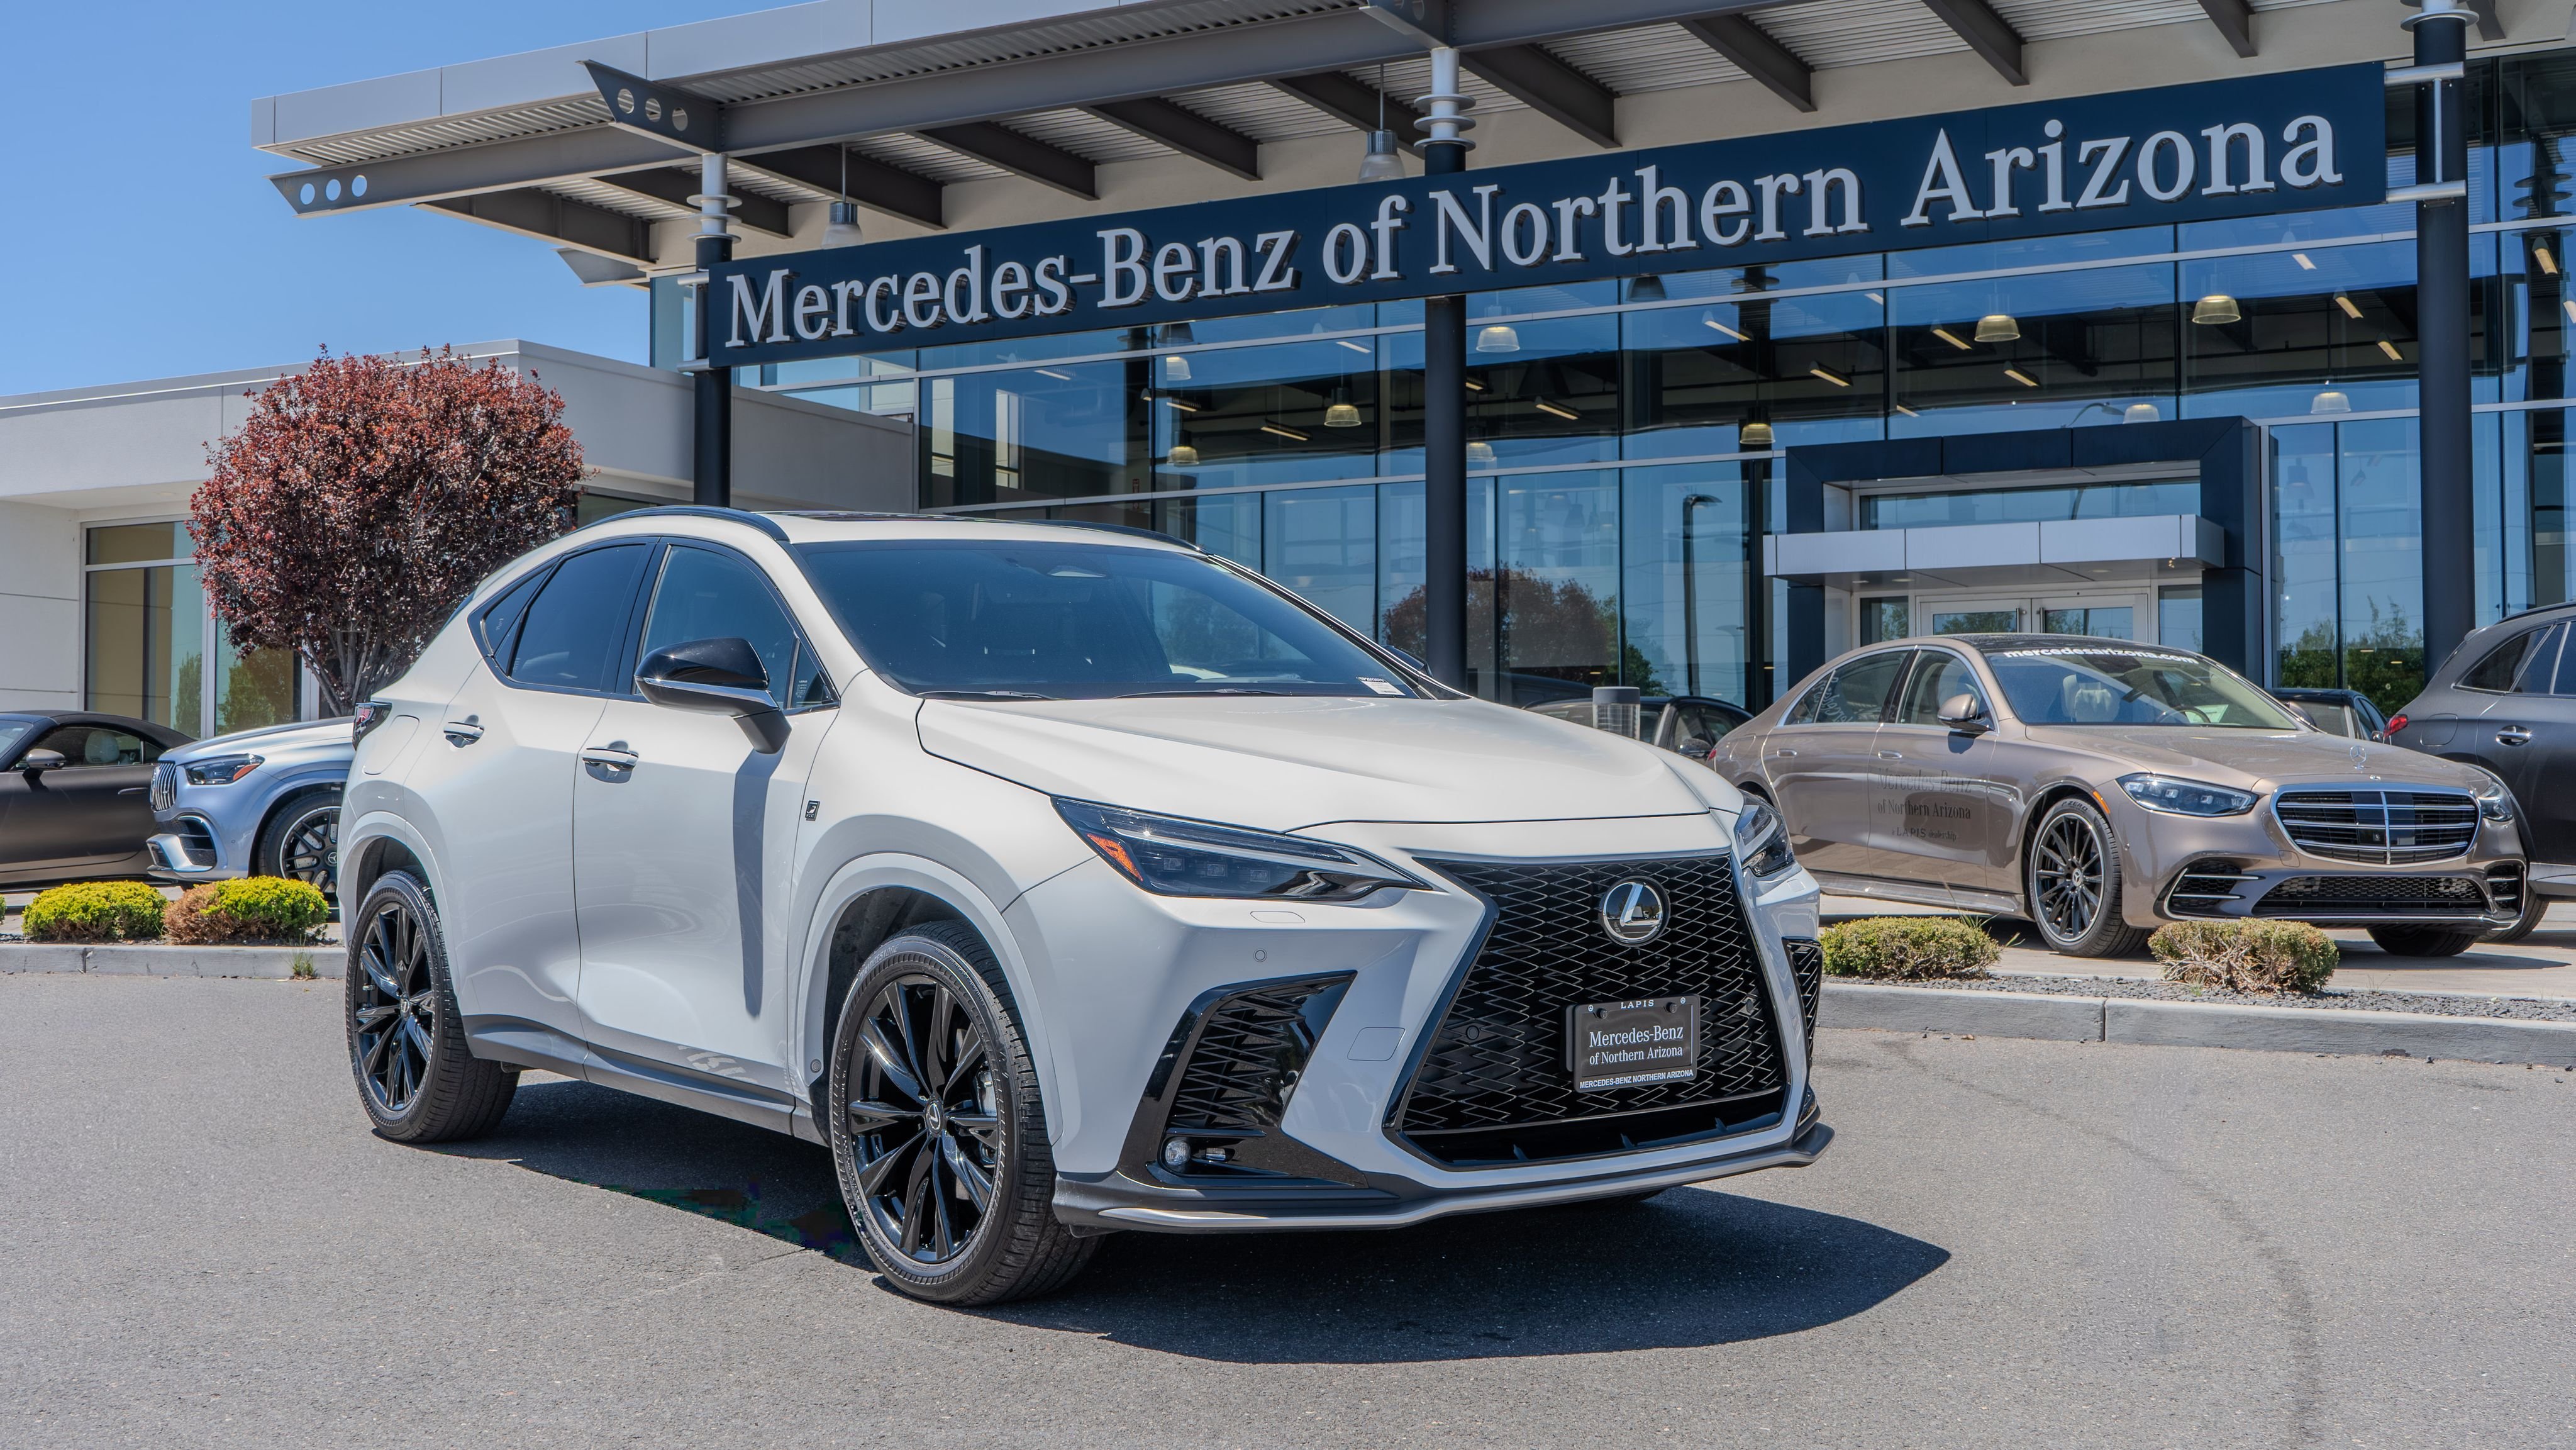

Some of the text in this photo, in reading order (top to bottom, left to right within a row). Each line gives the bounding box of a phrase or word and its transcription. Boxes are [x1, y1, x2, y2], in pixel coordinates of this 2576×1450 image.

[726, 114, 2343, 347] Mercedes-Benz of Northern Arizona
[2003, 647, 2199, 664] mercedesarizona.com
[1877, 767, 1973, 793] Mercedes-Benz
[1877, 799, 1971, 819] of Northern Arizona
[1897, 827, 1926, 839] LAPIS
[1928, 830, 1957, 842] dealership
[1621, 1000, 1654, 1009] LAPIS
[1589, 1025, 1684, 1048] Mercedes-Benz
[1589, 1046, 1683, 1065] of Northern Arizona
[1579, 1069, 1694, 1089] MERCEDES-BENZ NORTHERN ARIZONA
